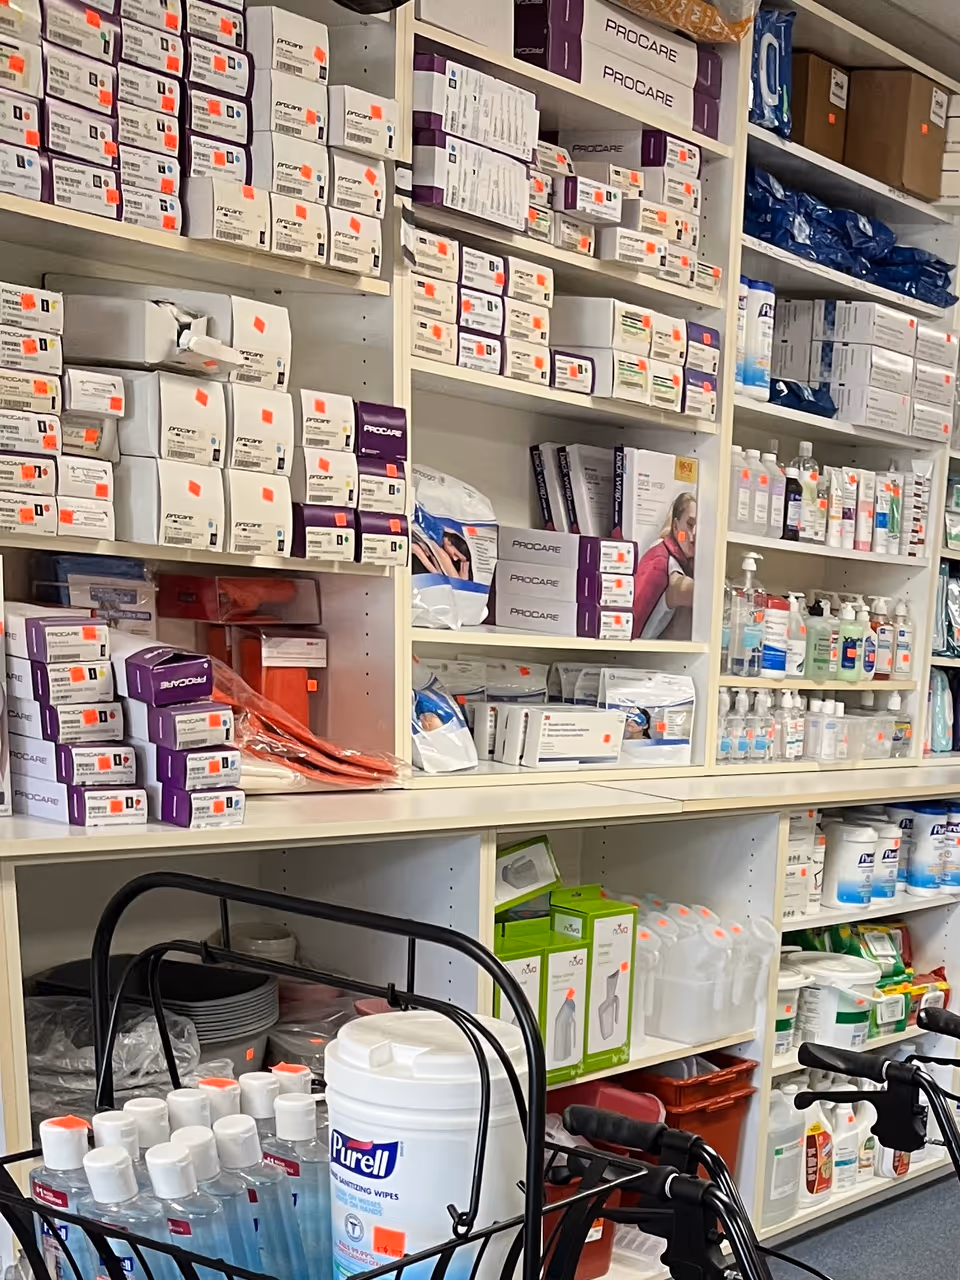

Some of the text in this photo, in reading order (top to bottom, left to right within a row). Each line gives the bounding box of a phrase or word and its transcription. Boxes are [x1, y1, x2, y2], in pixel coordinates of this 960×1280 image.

[277, 37, 304, 50] procare
[605, 18, 679, 63] PROCARE
[602, 65, 675, 108] PROCARE
[275, 100, 303, 112] procare
[572, 144, 624, 153] PROCARE
[168, 426, 197, 435] procare
[363, 424, 403, 438] PROCARE
[236, 436, 263, 446] procare
[614, 452, 624, 502] back wrap
[512, 540, 561, 553] PROCARE
[510, 574, 560, 587] PROCARE
[510, 607, 560, 621] PROCARE
[160, 675, 207, 690] PROCARE
[8, 710, 33, 722] CARE
[15, 789, 59, 806] PROCARE
[332, 1131, 389, 1177] Purell
[374, 1189, 400, 1201] WIPES
